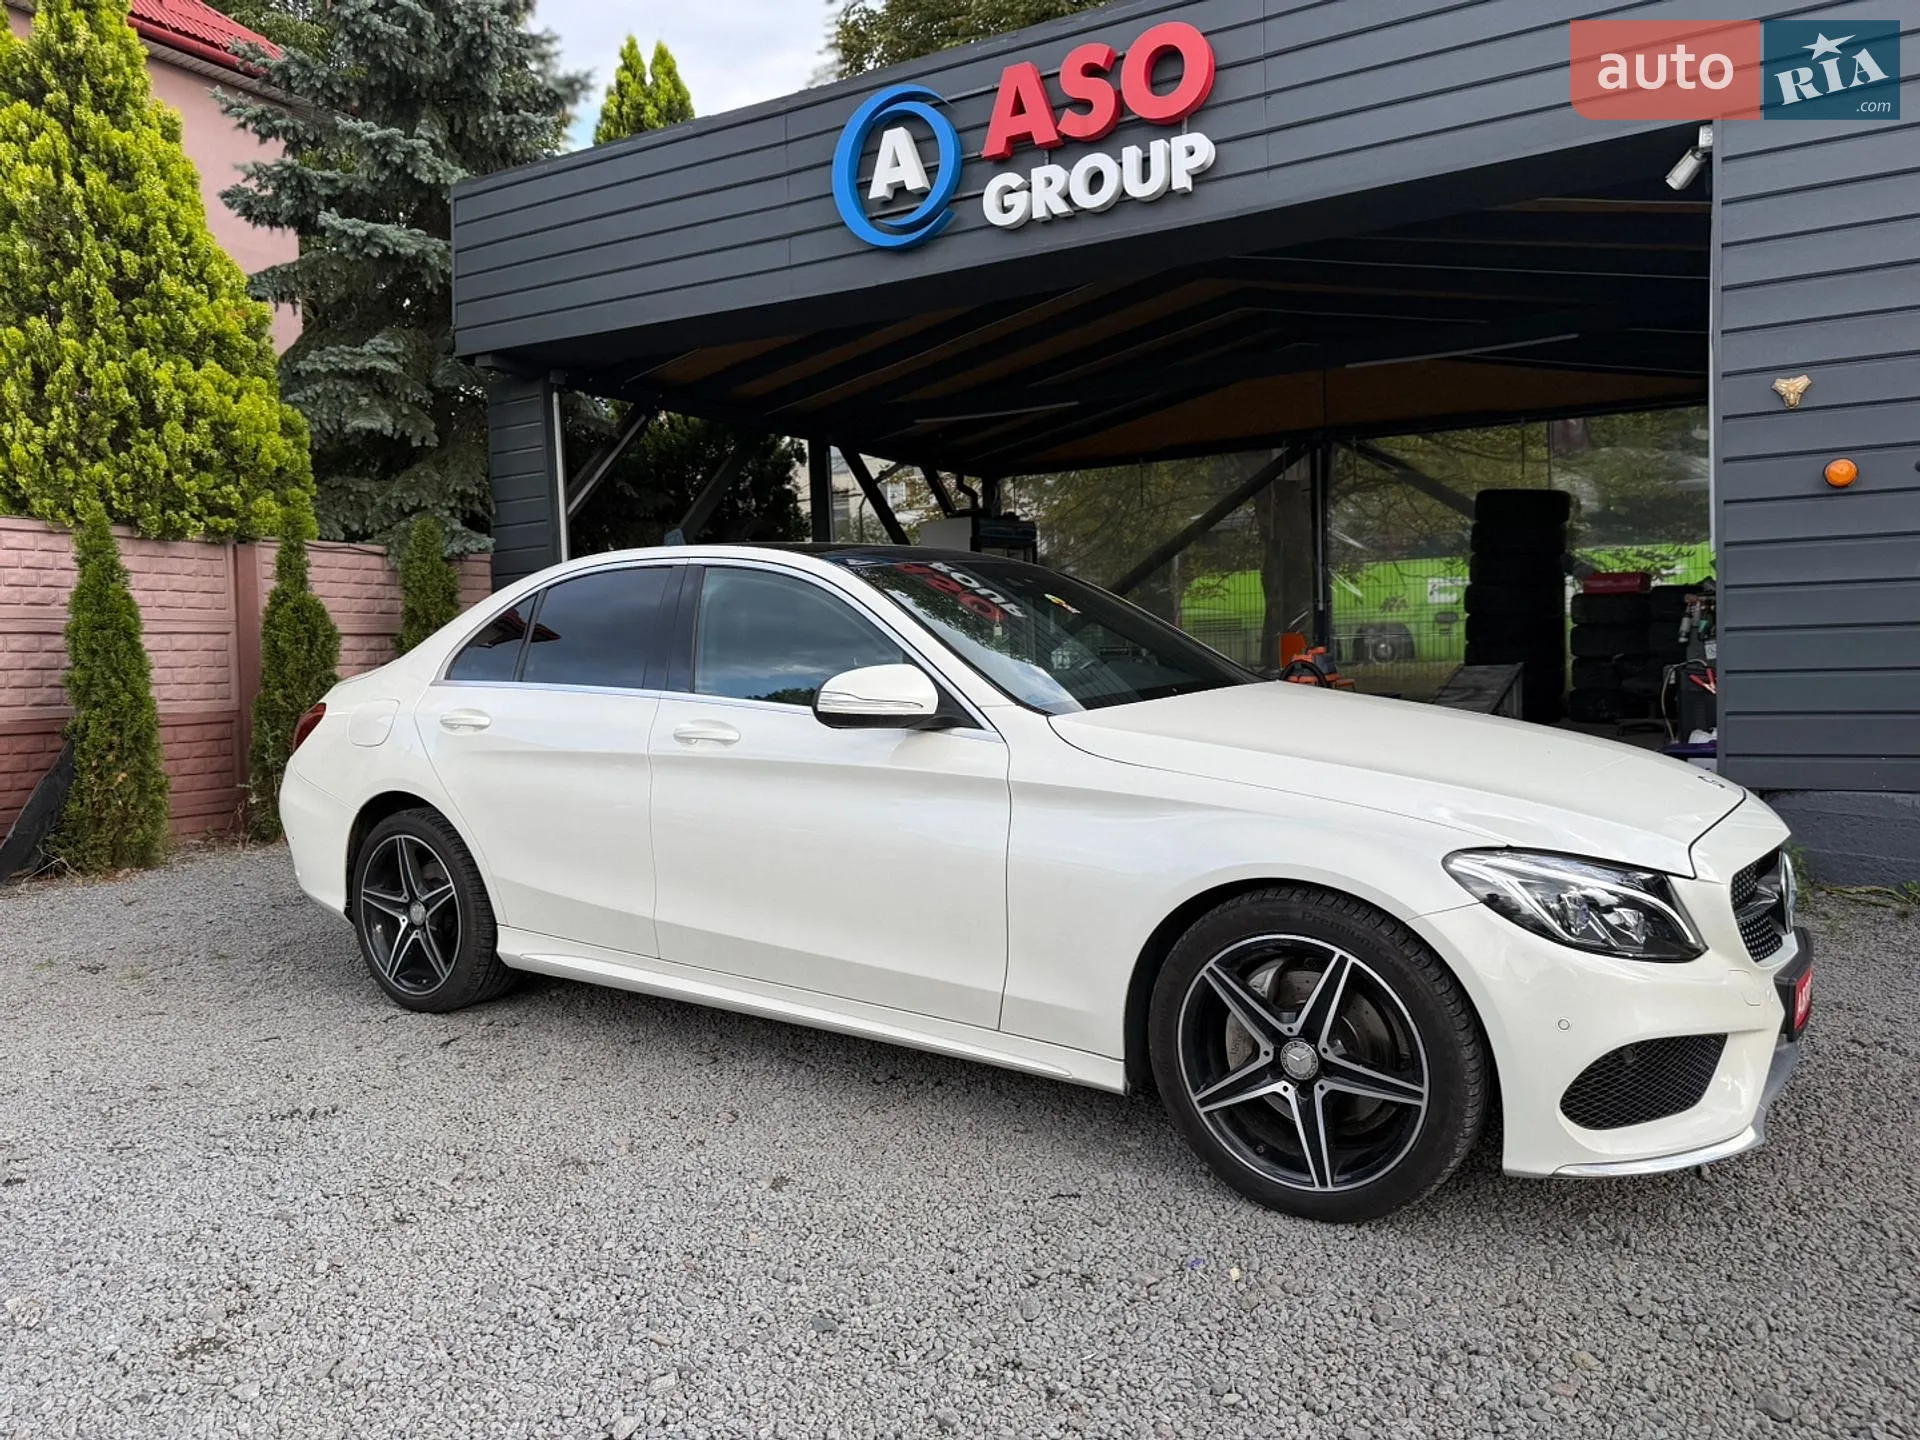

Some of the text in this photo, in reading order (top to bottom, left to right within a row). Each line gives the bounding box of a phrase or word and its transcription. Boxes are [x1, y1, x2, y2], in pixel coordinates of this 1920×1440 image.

[981, 21, 1215, 161] ASO
[868, 126, 931, 201] A
[982, 132, 1216, 230] GROUP
